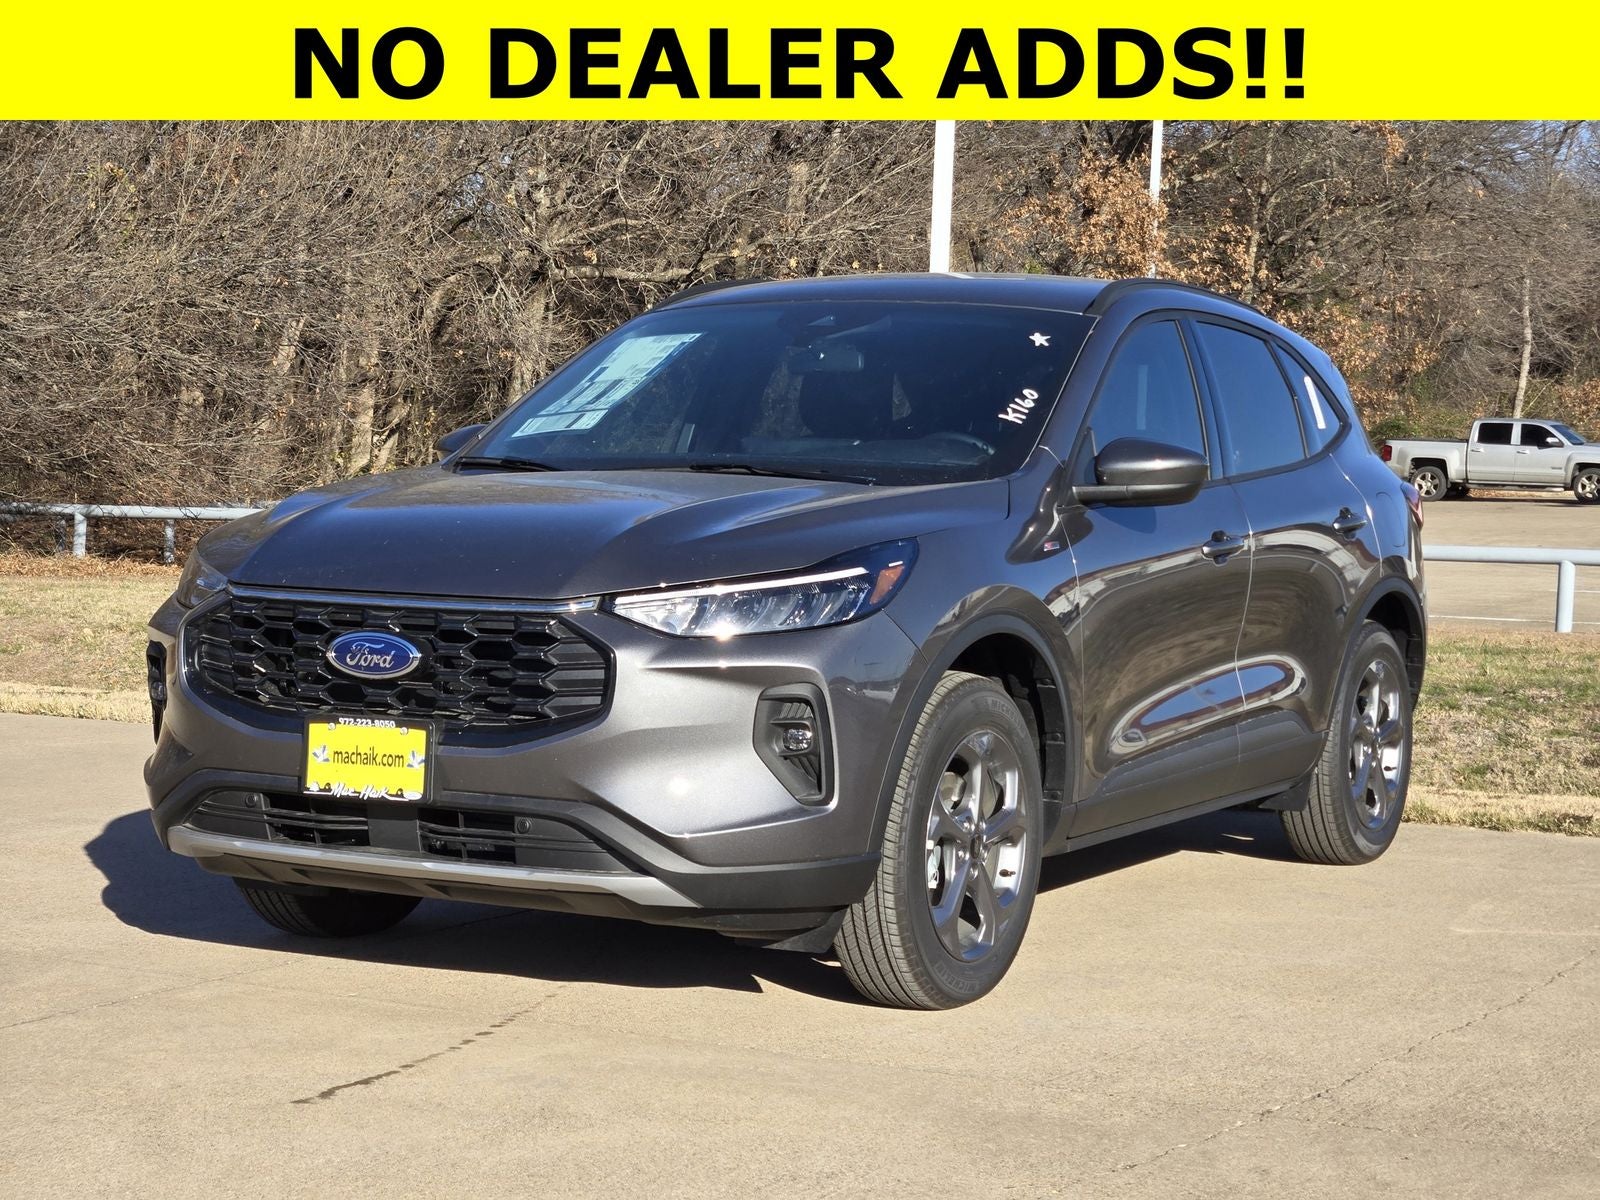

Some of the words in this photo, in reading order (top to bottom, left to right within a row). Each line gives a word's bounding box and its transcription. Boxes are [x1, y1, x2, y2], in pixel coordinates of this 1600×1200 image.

[346, 641, 396, 668] Ford
[338, 717, 396, 729] 972-223-8050
[332, 745, 405, 768] machaik.com
[359, 784, 391, 800] Haik
